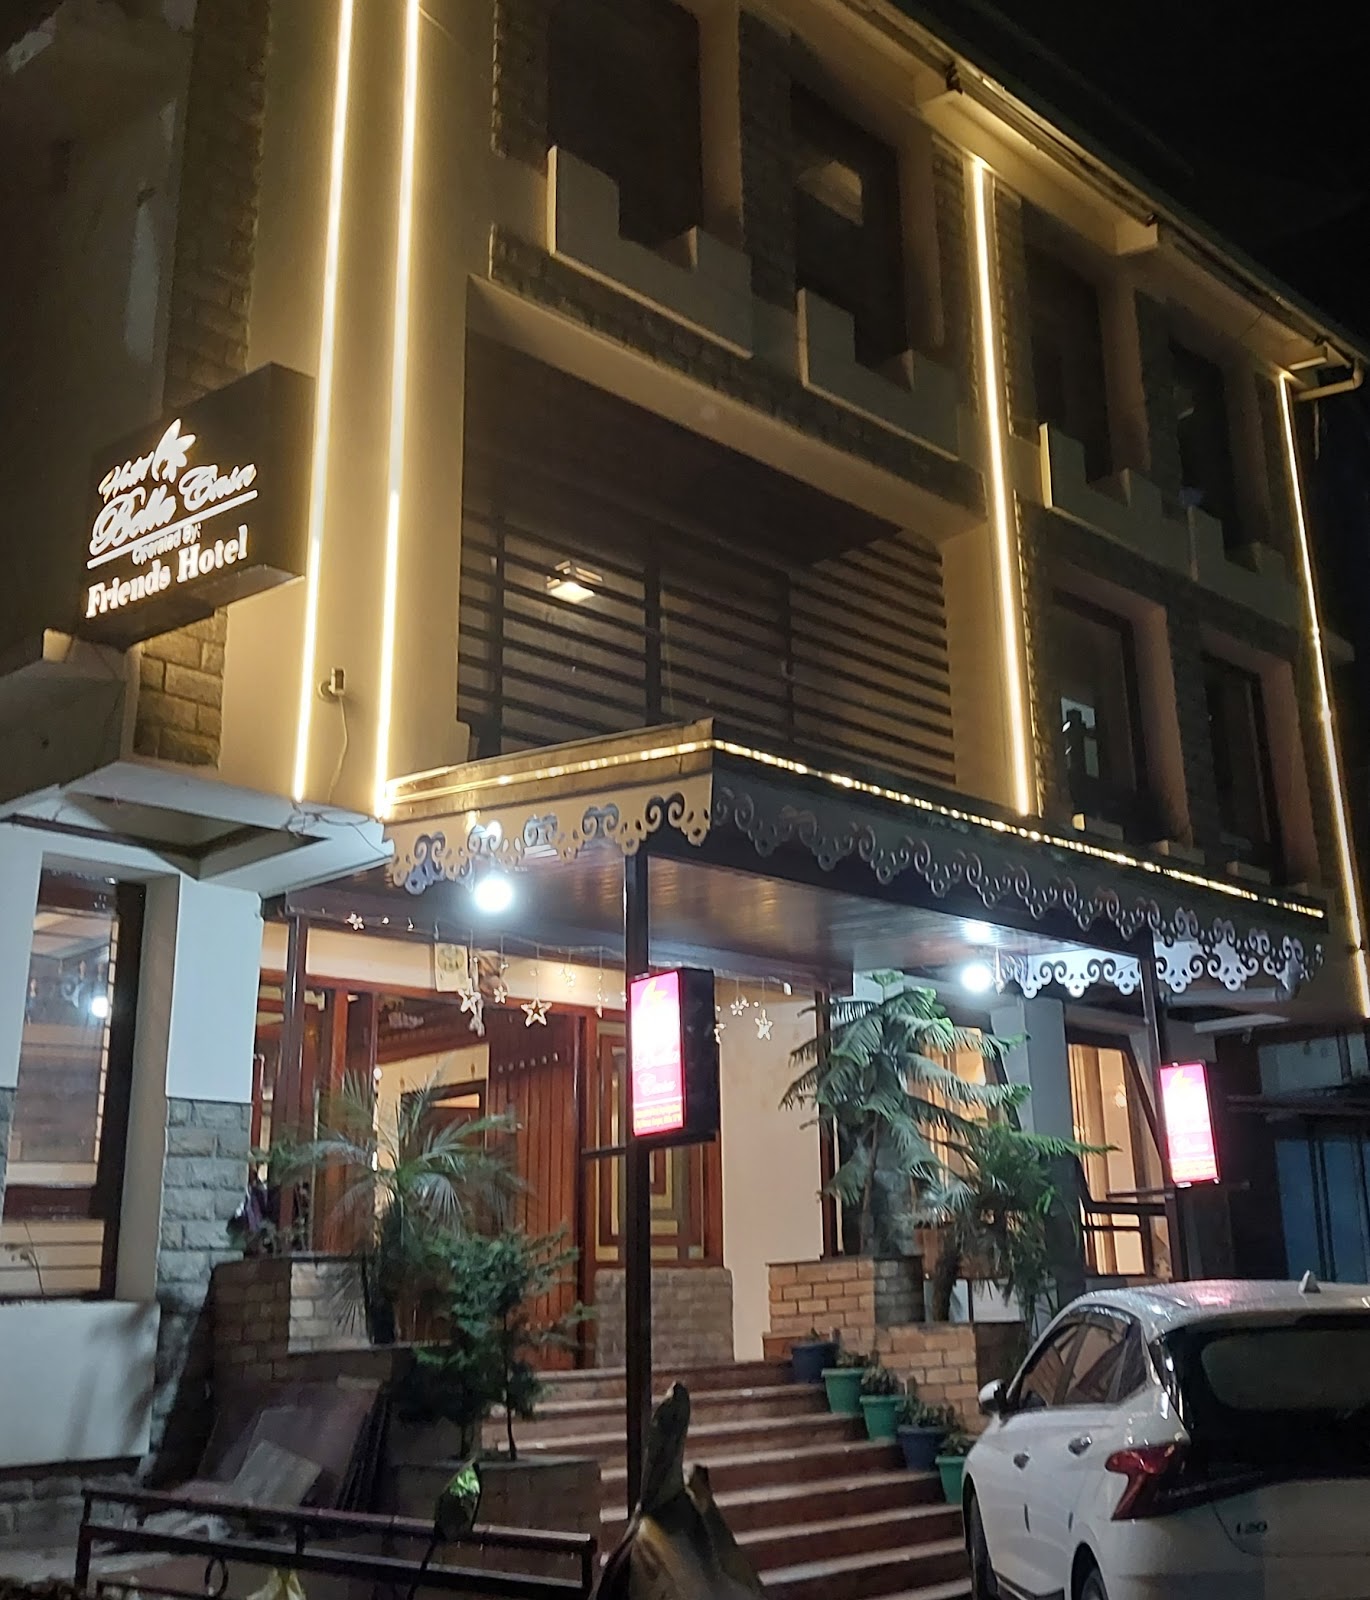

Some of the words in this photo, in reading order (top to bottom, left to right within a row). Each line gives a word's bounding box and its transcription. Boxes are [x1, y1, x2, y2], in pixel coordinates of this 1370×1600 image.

[179, 463, 257, 511] Casa
[85, 559, 171, 618] Friends
[176, 524, 248, 583] Hotel
[131, 530, 179, 566] Operated
